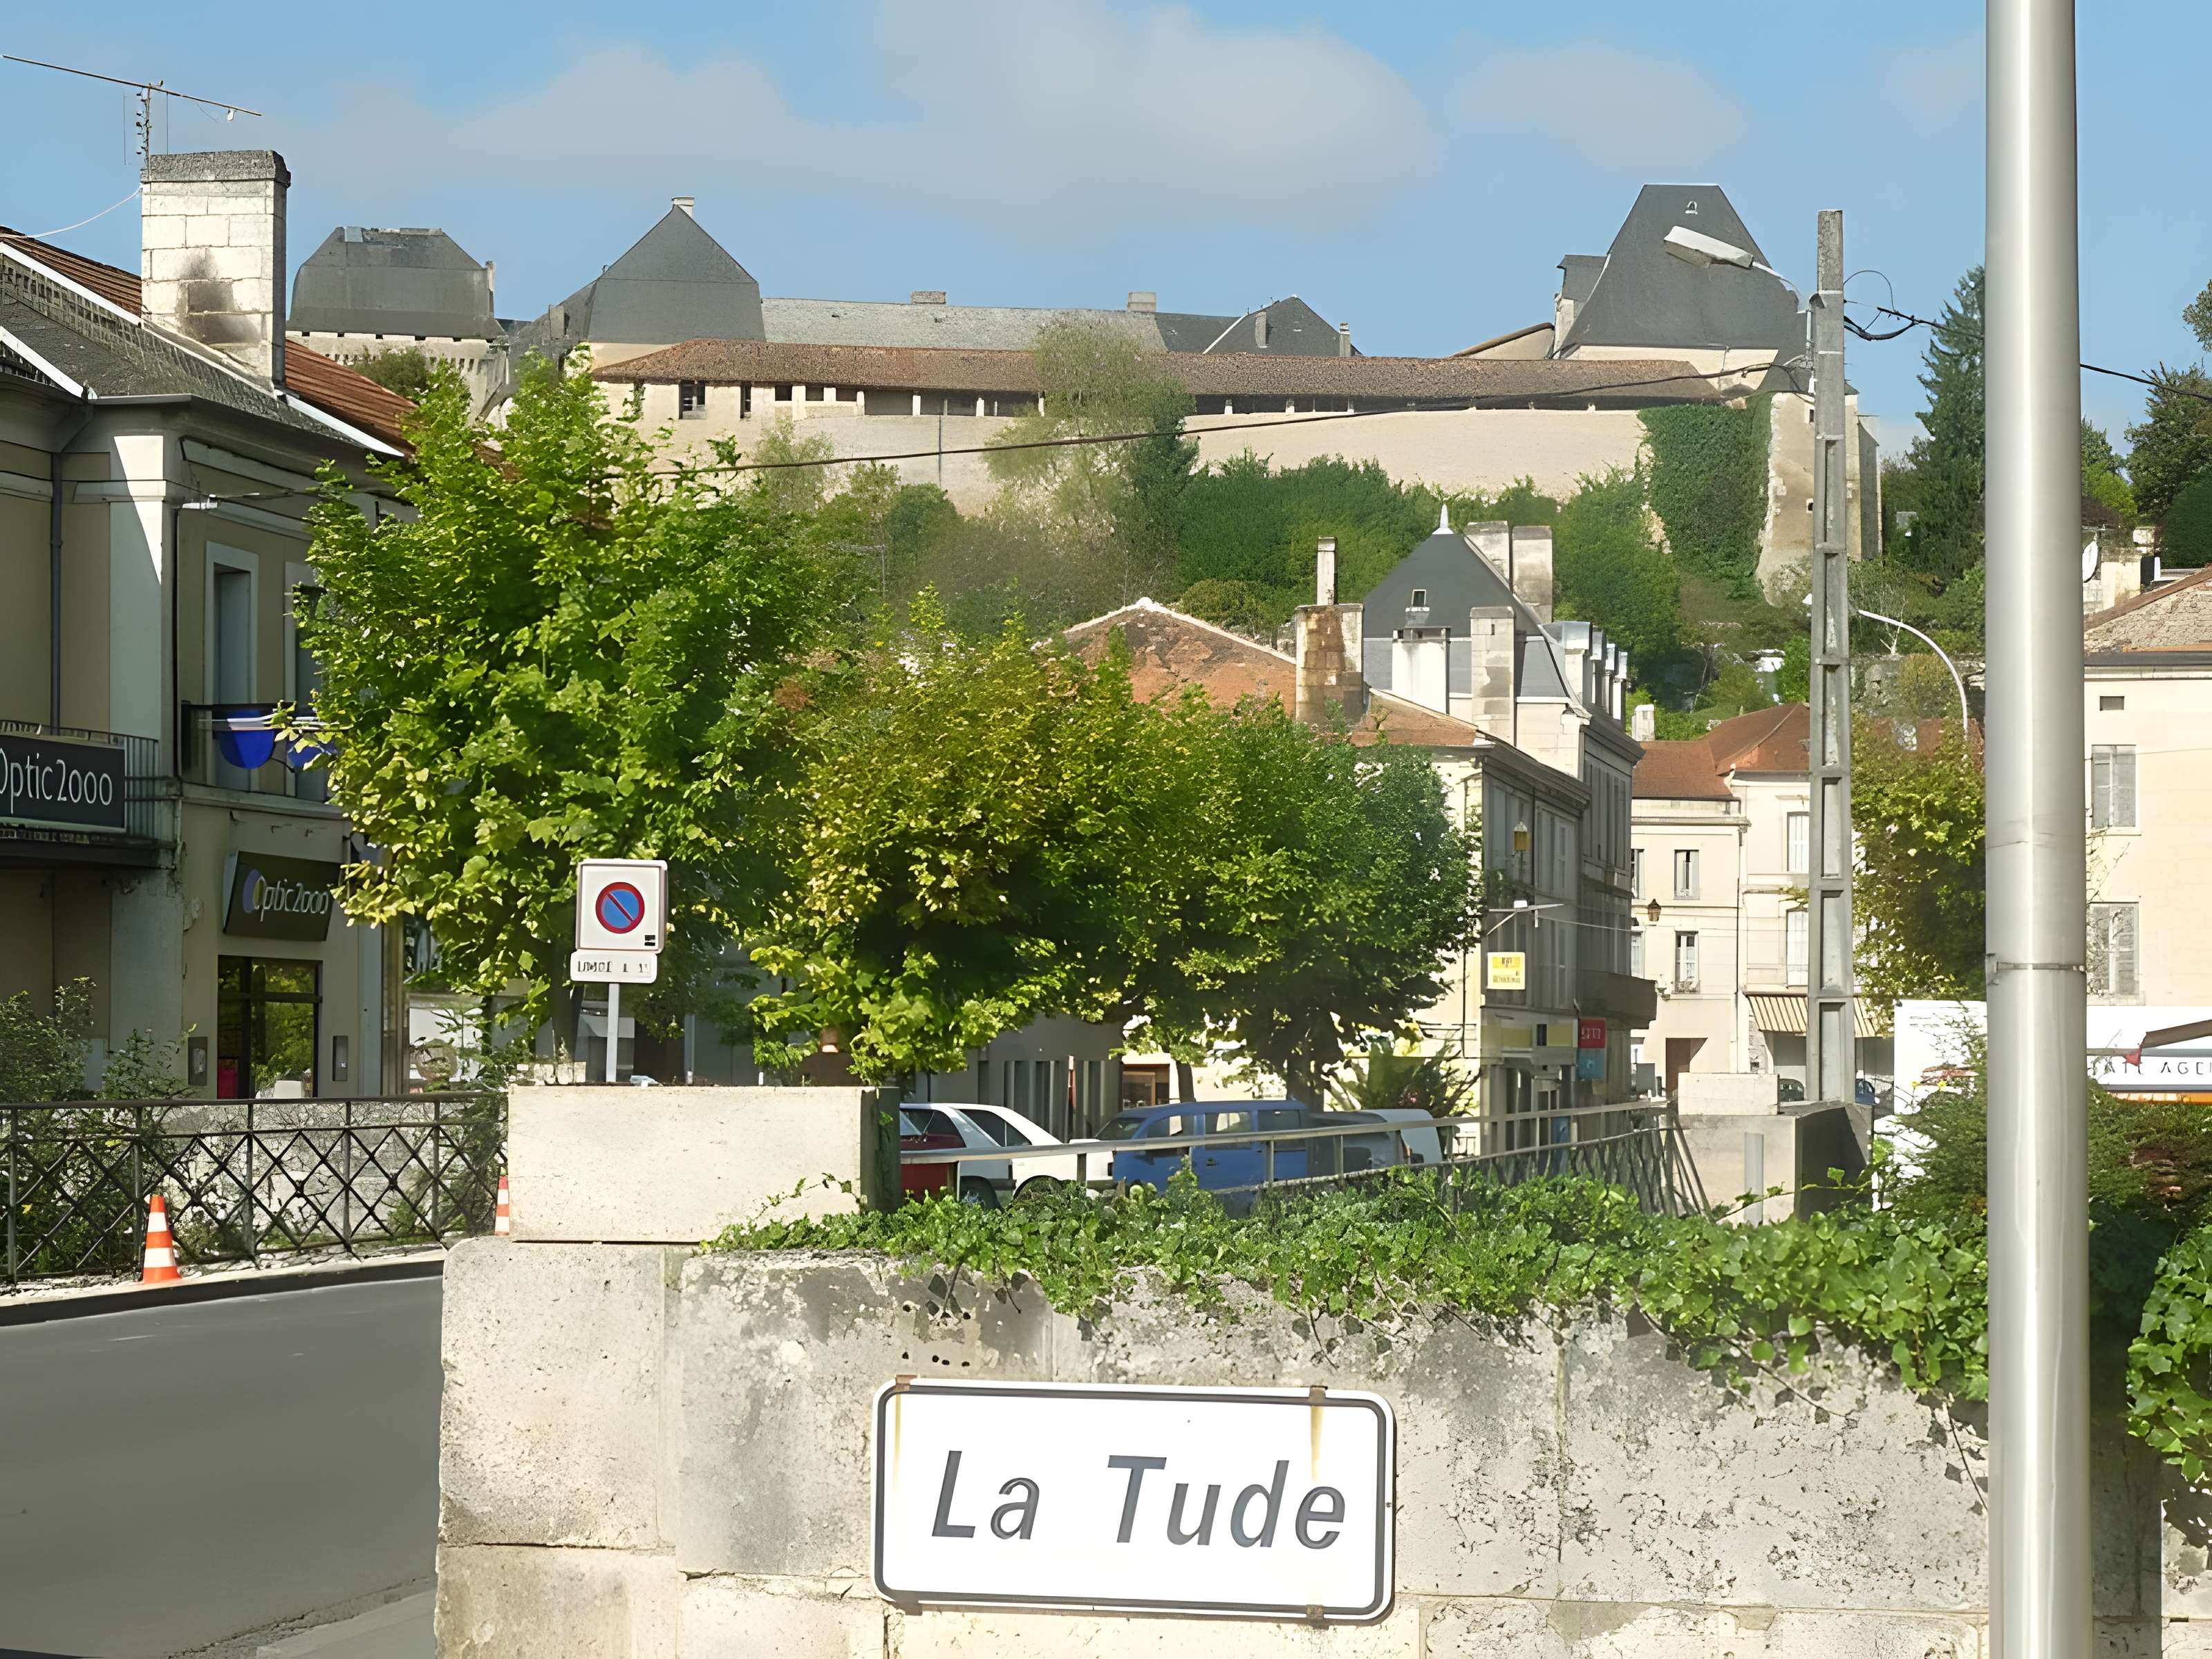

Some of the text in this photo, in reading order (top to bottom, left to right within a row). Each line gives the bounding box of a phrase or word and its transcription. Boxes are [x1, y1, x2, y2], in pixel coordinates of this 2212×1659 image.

[2160, 1061, 2212, 1076] AGE
[931, 1450, 1346, 1550] La Tude
